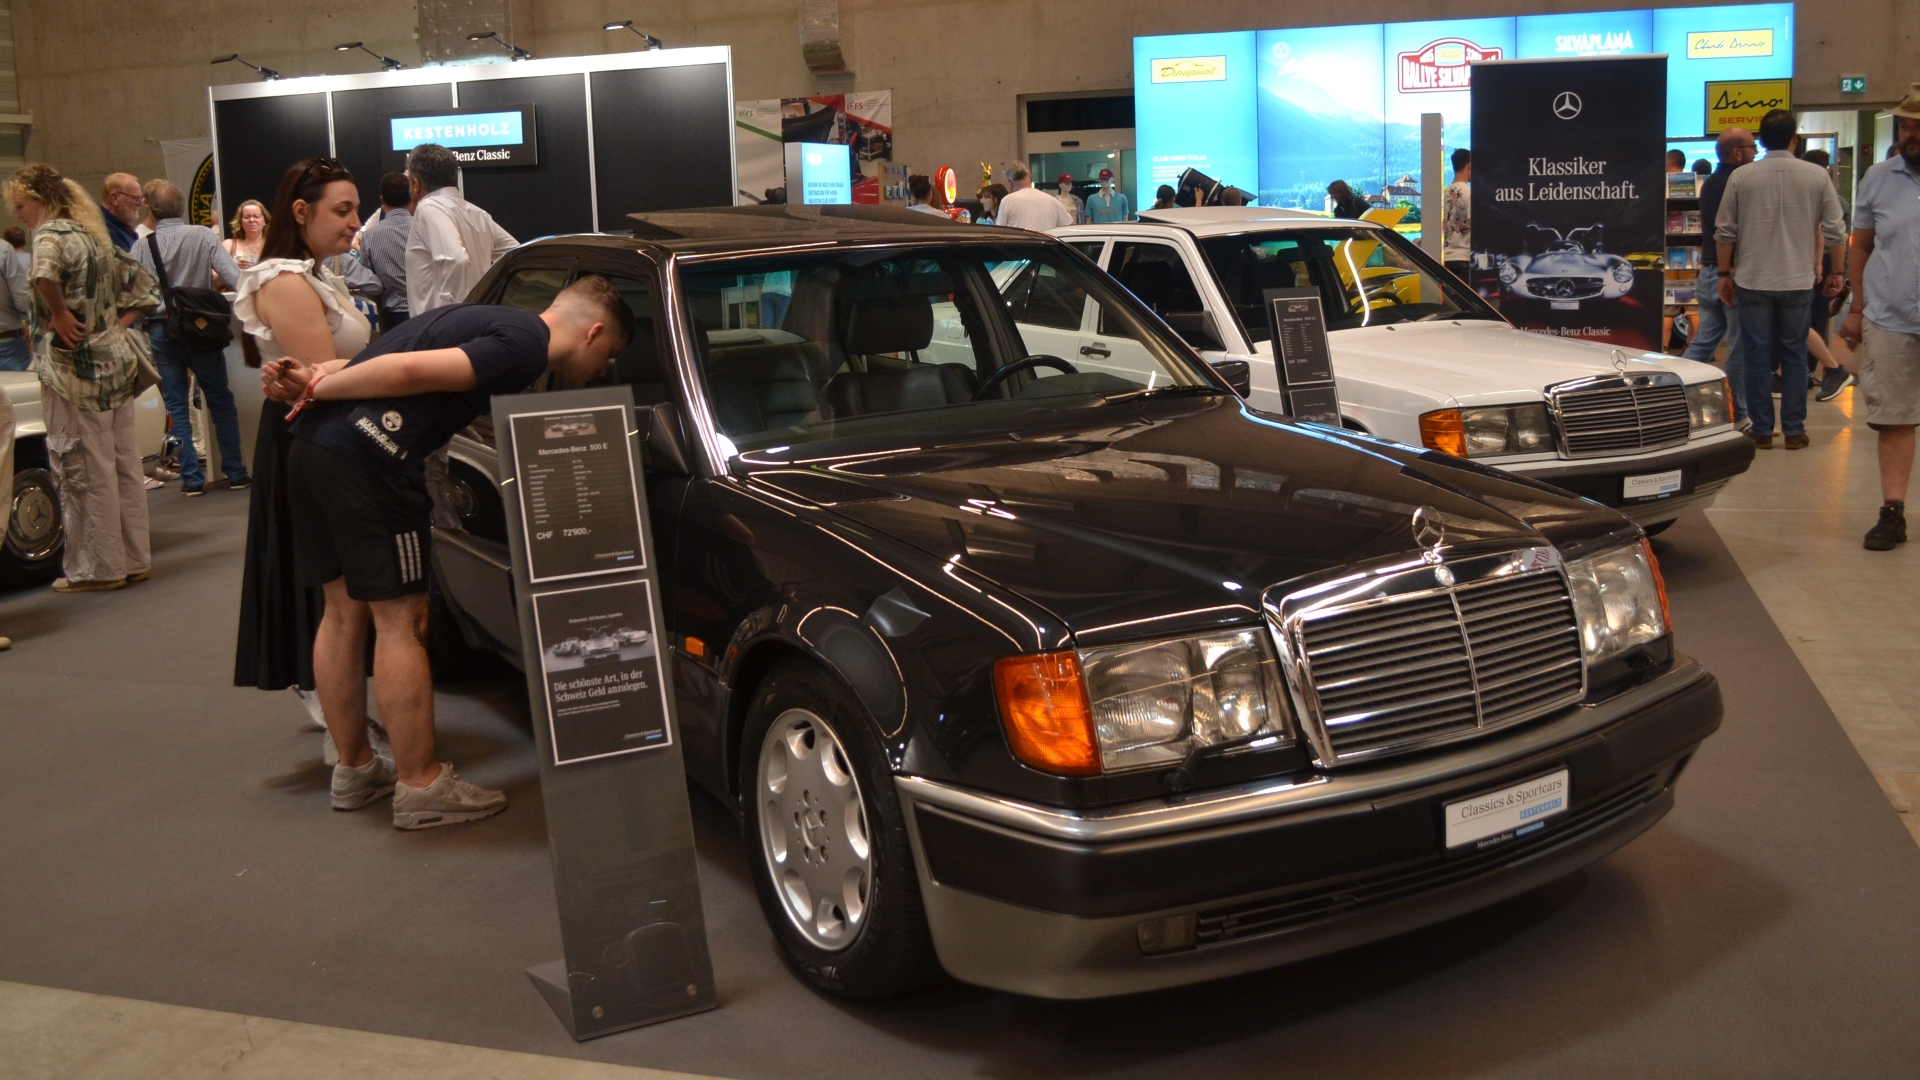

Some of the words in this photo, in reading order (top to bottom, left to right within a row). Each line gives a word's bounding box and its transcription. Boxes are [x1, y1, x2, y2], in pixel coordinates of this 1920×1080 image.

[1555, 30, 1634, 52] SILVAPLANA
[1403, 58, 1438, 88] RALLYE
[1712, 90, 1783, 110] Dino
[1718, 116, 1764, 124] SERVIC
[403, 122, 510, 140] KESTENHOLZ
[476, 148, 510, 160] Classic
[1528, 156, 1606, 176] Klassiker
[1496, 187, 1523, 201] aus
[1528, 180, 1639, 201] Leidenschaft.
[1520, 326, 1580, 336] Mercedes-Benz
[1582, 326, 1610, 336] Classic
[538, 446, 587, 455] Mercedes-Benz
[536, 531, 553, 540] CHF
[554, 681, 567, 692] Die
[569, 677, 602, 689] schönste
[604, 675, 620, 685] Art,
[621, 672, 629, 681] in
[630, 670, 644, 679] der
[555, 690, 587, 703] Schweiz
[588, 687, 606, 697] Geld
[608, 681, 648, 695] anzulegen.
[1461, 798, 1504, 819] Classics
[1506, 794, 1514, 805] &
[1516, 779, 1562, 804] Sportcars
[1520, 798, 1561, 819] KESTENHOLZ
